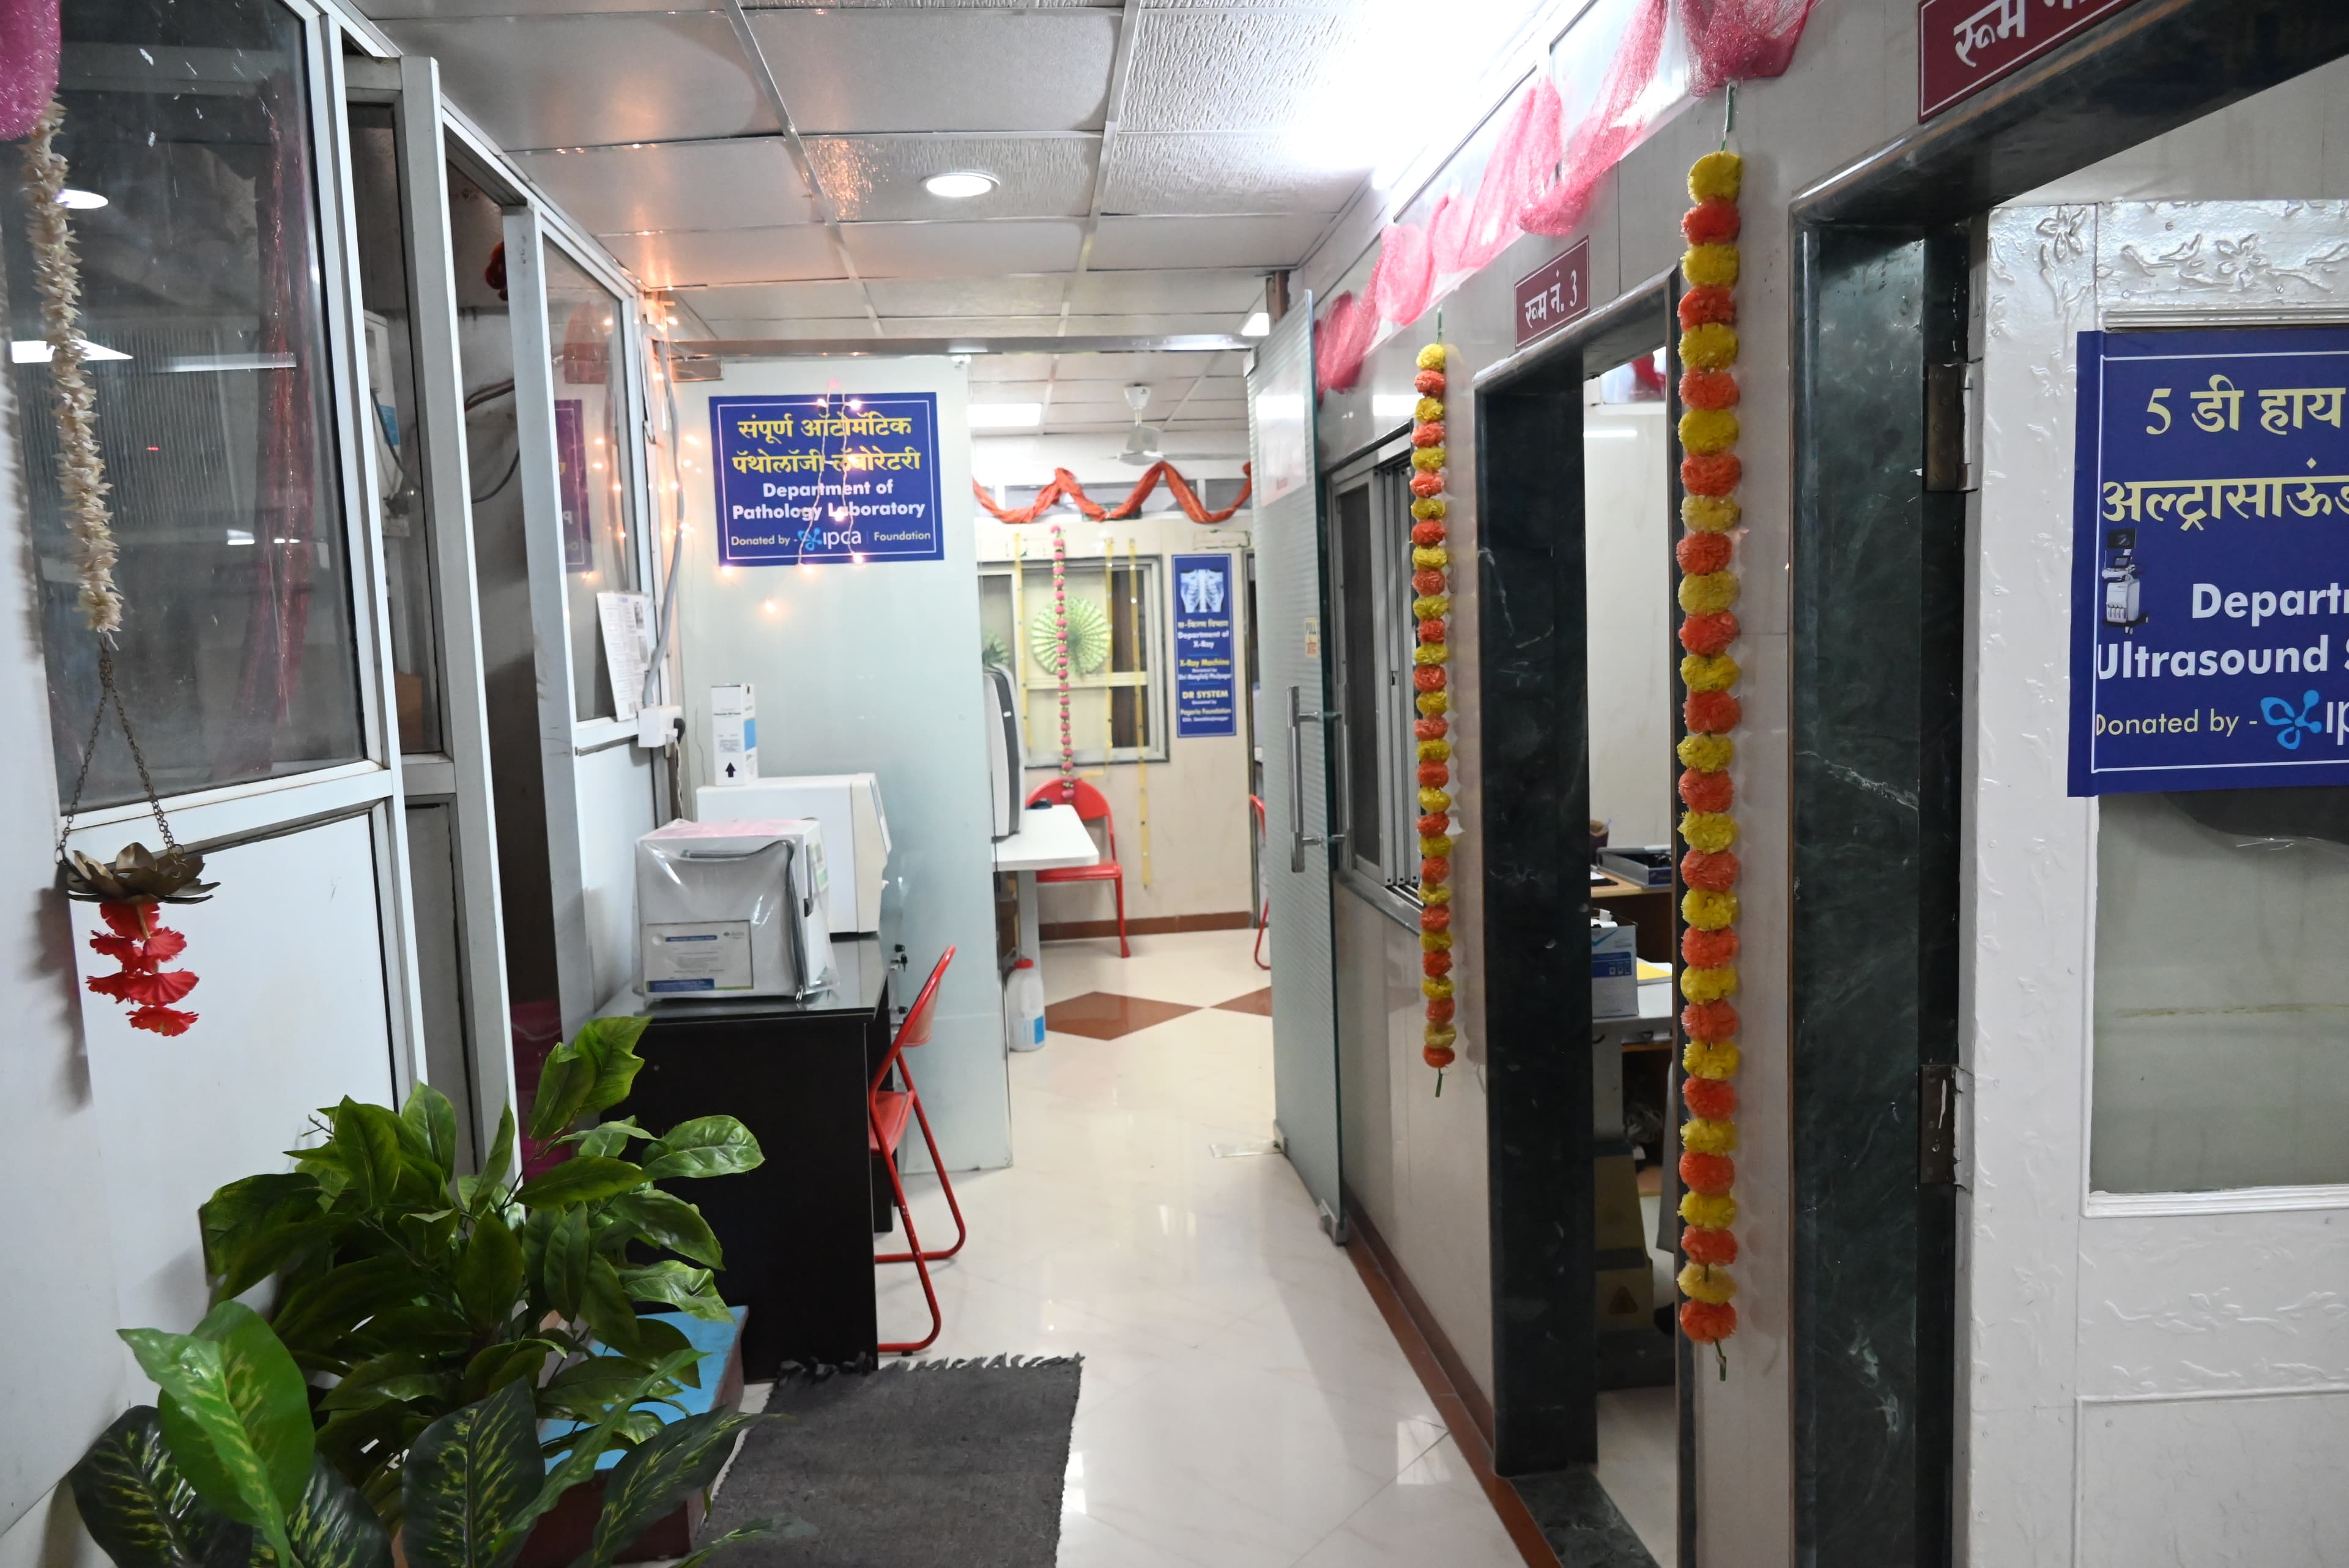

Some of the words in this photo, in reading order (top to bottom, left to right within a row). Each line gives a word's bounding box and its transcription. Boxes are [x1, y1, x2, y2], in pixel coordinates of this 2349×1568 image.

[1525, 290, 1548, 329] रूम
[2146, 387, 2172, 435] 5
[2190, 374, 2244, 433] डी
[2258, 387, 2346, 436] हाय
[737, 413, 794, 445] संपूर्ण
[800, 411, 912, 437] ऑटोमॅटिक
[732, 448, 825, 474] पॅथोलॉजी
[763, 481, 870, 500] Department
[875, 478, 894, 494] of
[732, 503, 823, 521] Pathology
[828, 502, 926, 518] Laboratory
[731, 535, 776, 546] Donated
[778, 535, 790, 546] by
[874, 530, 931, 541] Foundation
[2192, 582, 2349, 627] Depart
[2096, 634, 2328, 680] Ultrasound
[1197, 689, 1229, 699] SYSTEM
[2096, 709, 2199, 736] Donated
[2210, 706, 2240, 738] by
